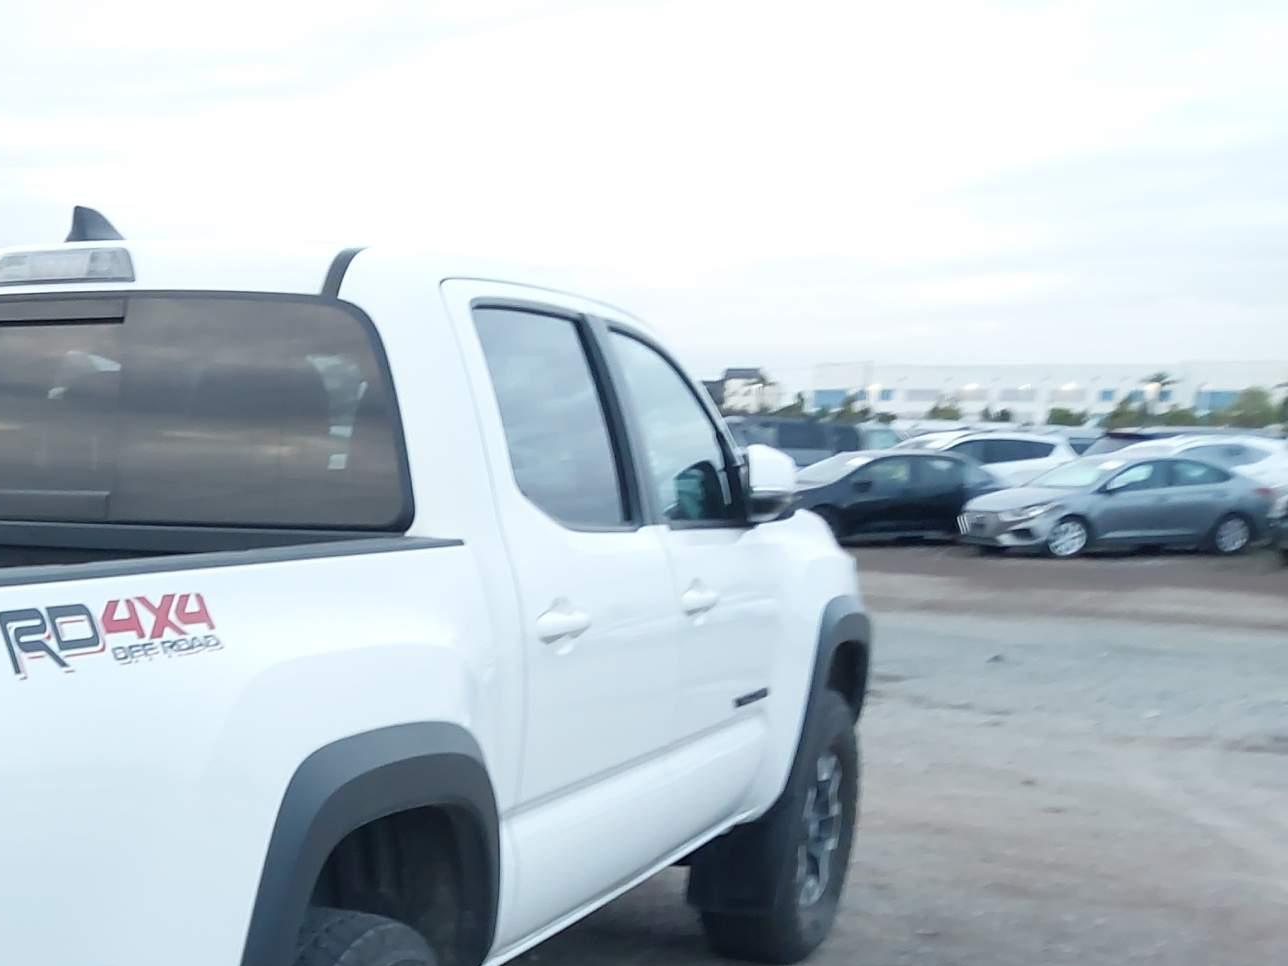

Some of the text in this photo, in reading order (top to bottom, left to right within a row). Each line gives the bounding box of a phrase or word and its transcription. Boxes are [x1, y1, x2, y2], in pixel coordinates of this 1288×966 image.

[101, 593, 216, 639] 4X4
[112, 634, 224, 665] OFF ROAD
